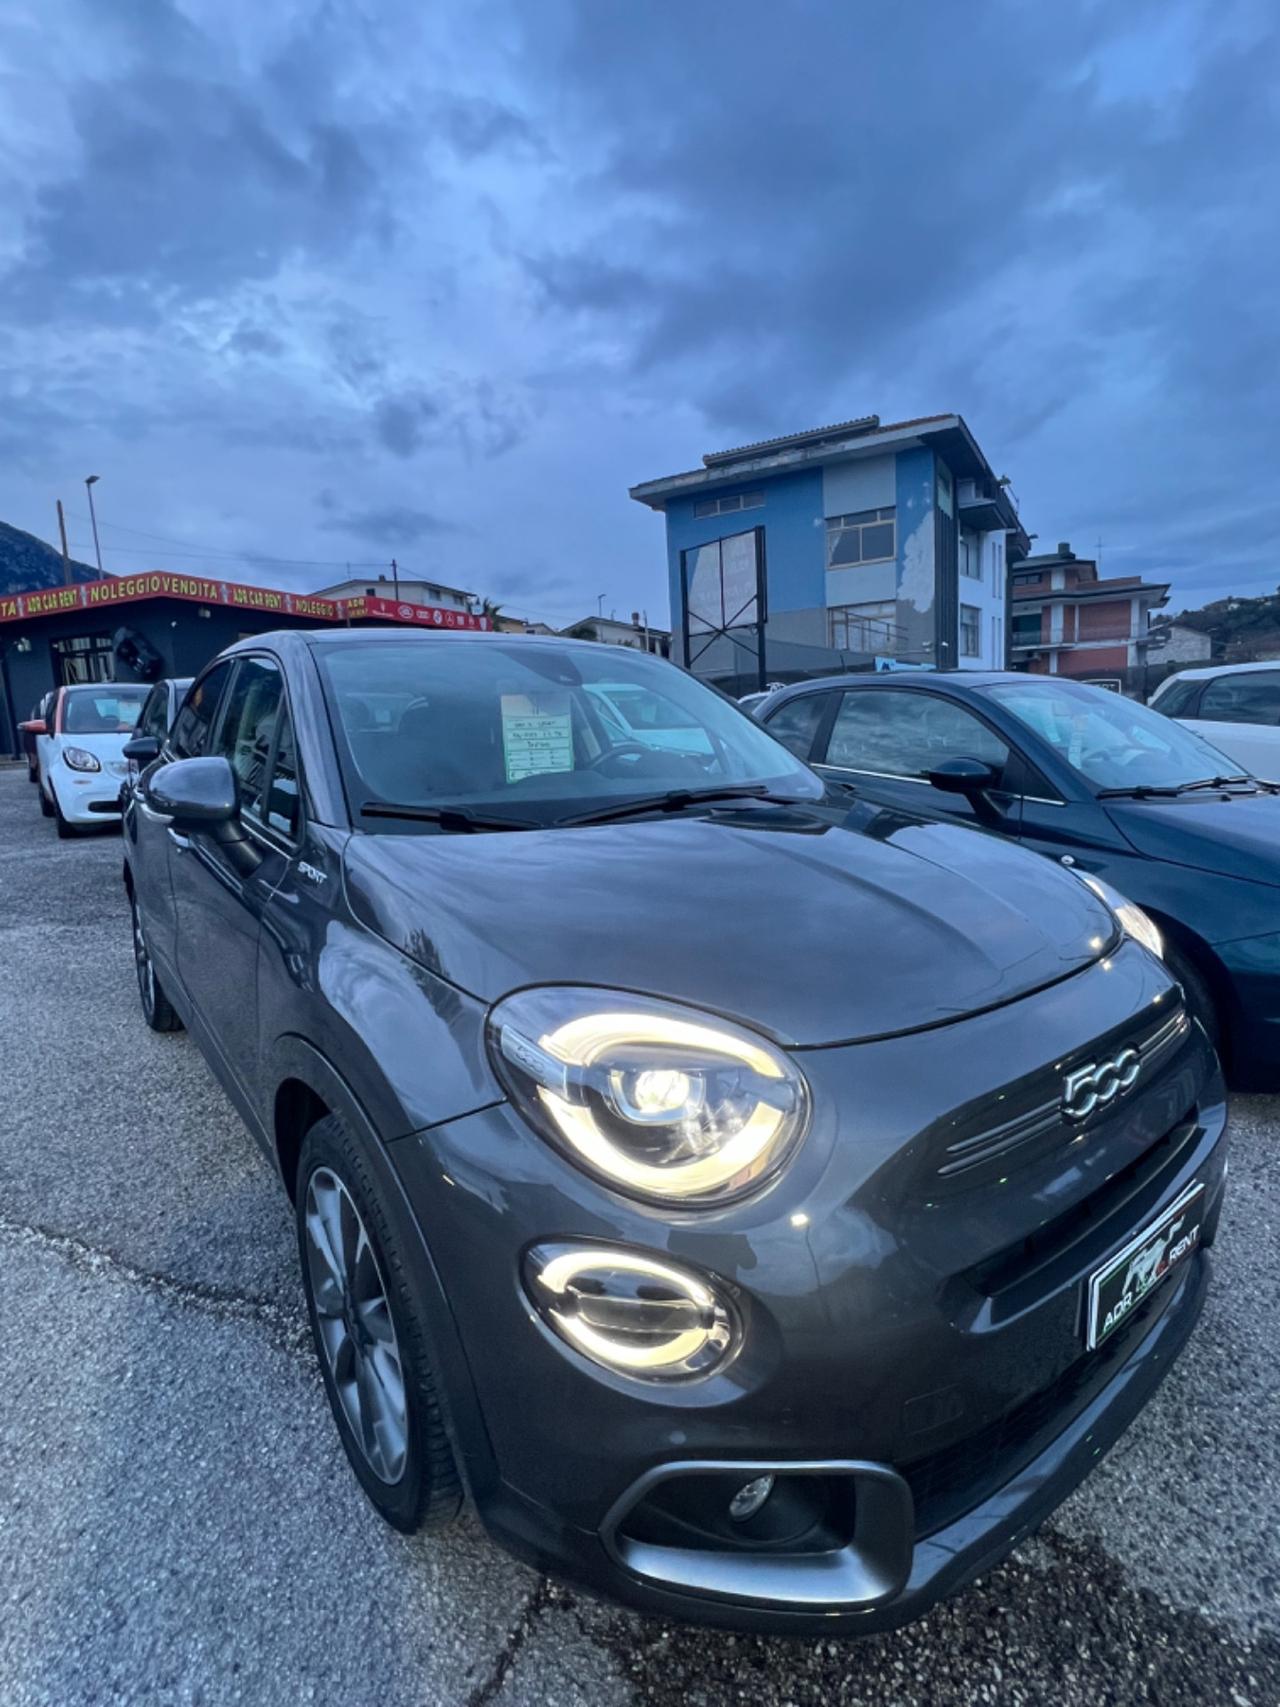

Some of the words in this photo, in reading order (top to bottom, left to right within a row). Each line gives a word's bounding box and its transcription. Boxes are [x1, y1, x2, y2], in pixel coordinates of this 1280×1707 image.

[43, 593, 57, 610] CAR
[59, 589, 77, 608] RENT
[90, 576, 159, 602] NOLEGGIO
[160, 576, 218, 600] VENDITA
[296, 599, 335, 617] NOLEGGIO
[297, 861, 327, 884] SPORT
[1062, 1049, 1140, 1117] 500
[1103, 1291, 1134, 1333] ADR
[1168, 1223, 1201, 1263] RENT
